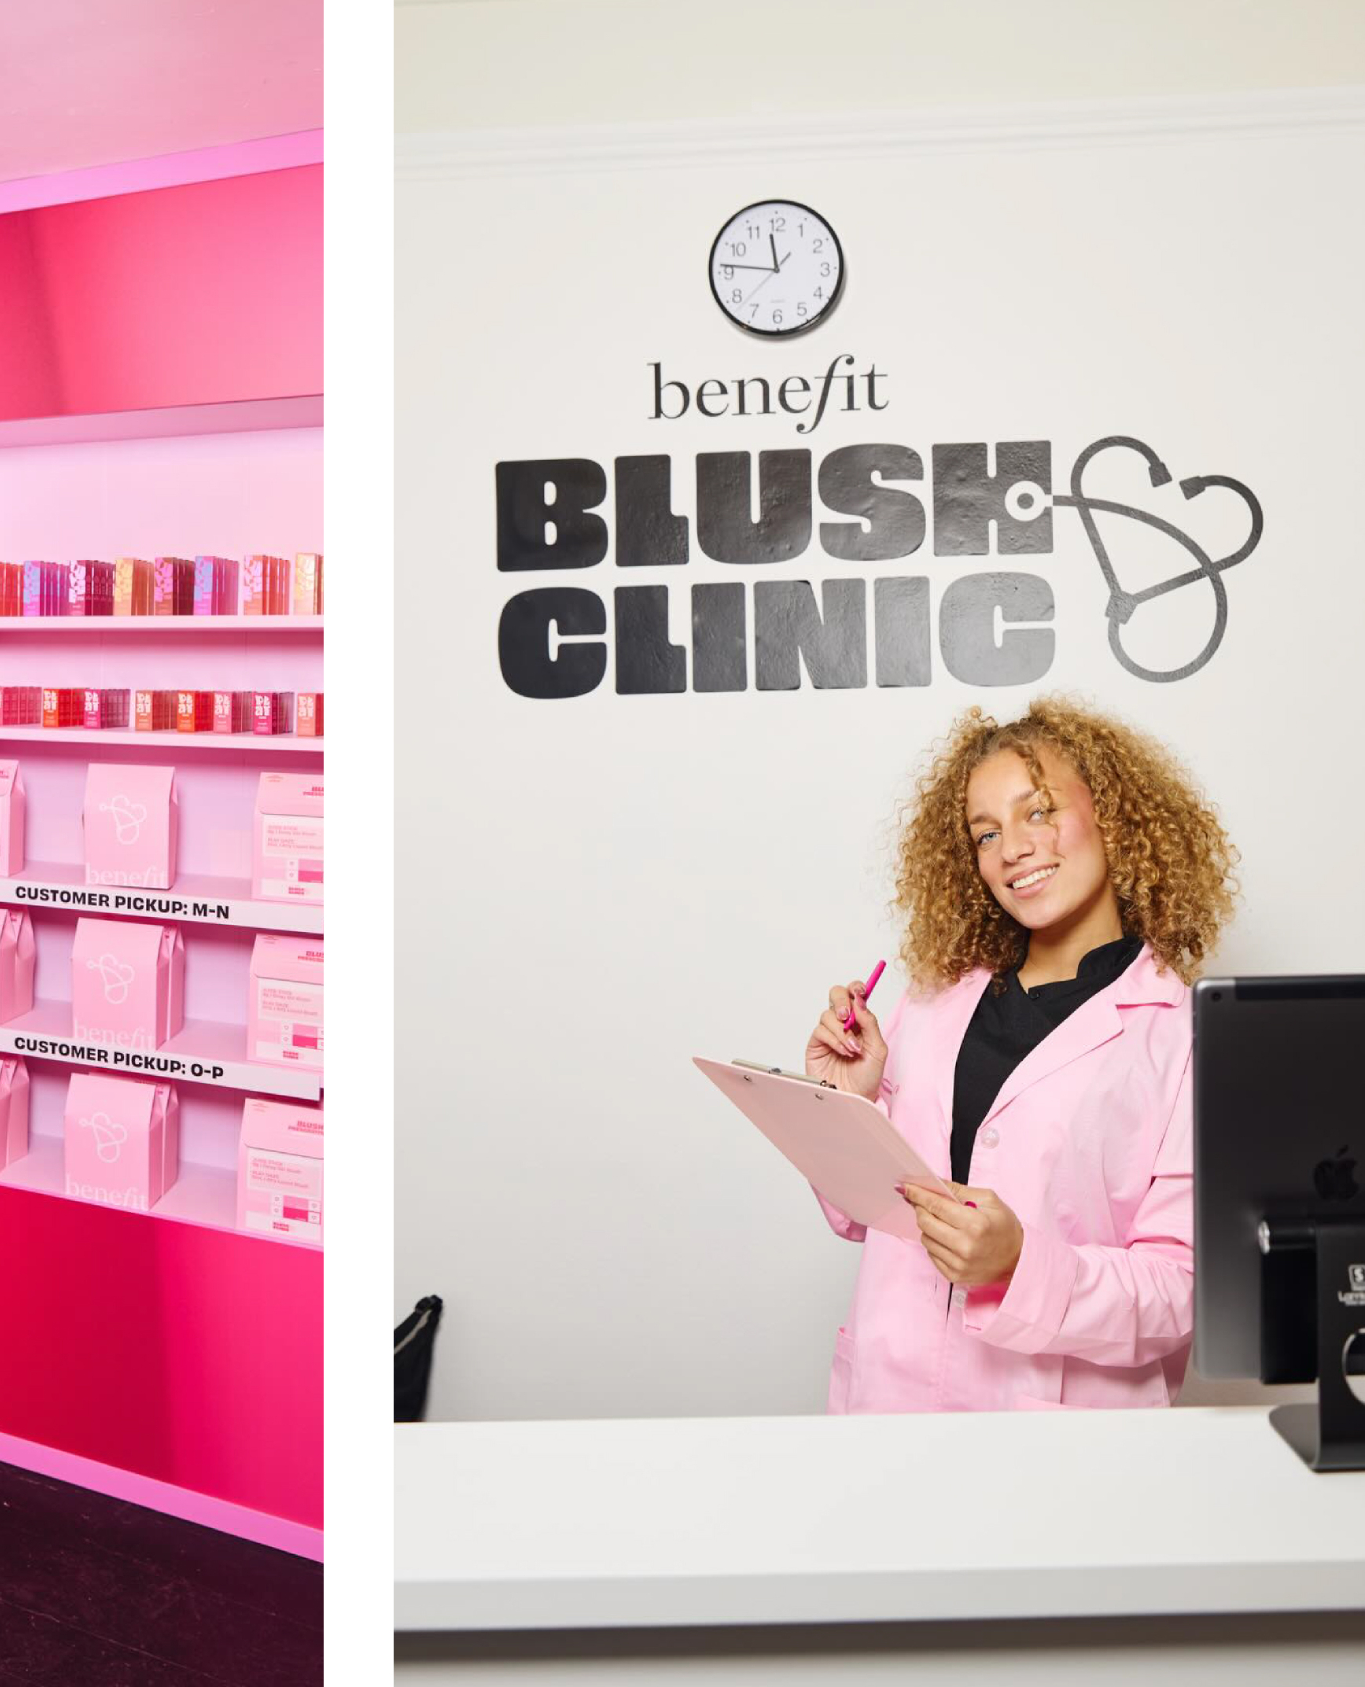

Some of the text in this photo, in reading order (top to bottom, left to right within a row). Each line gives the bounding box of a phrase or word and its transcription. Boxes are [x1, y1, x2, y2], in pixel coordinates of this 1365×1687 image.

[746, 225, 760, 240] 11
[769, 217, 786, 232] 12
[798, 223, 804, 238] 1
[730, 242, 747, 257] 10
[812, 239, 823, 254] 2
[723, 265, 735, 281] 9
[820, 262, 830, 277] 3
[731, 288, 743, 304] 8
[813, 286, 823, 300] 4
[749, 303, 760, 319] 7
[772, 309, 783, 324] 6
[797, 301, 808, 317] 5
[646, 354, 889, 435] benefit
[495, 440, 1054, 573] BLUSH
[497, 571, 1056, 700] CLINIC
[15, 886, 231, 920] CUSTOMER PICKUP: M-N
[14, 1037, 224, 1080] CUSTOMER PICKUP: O-P
[65, 1174, 148, 1212] benefit
